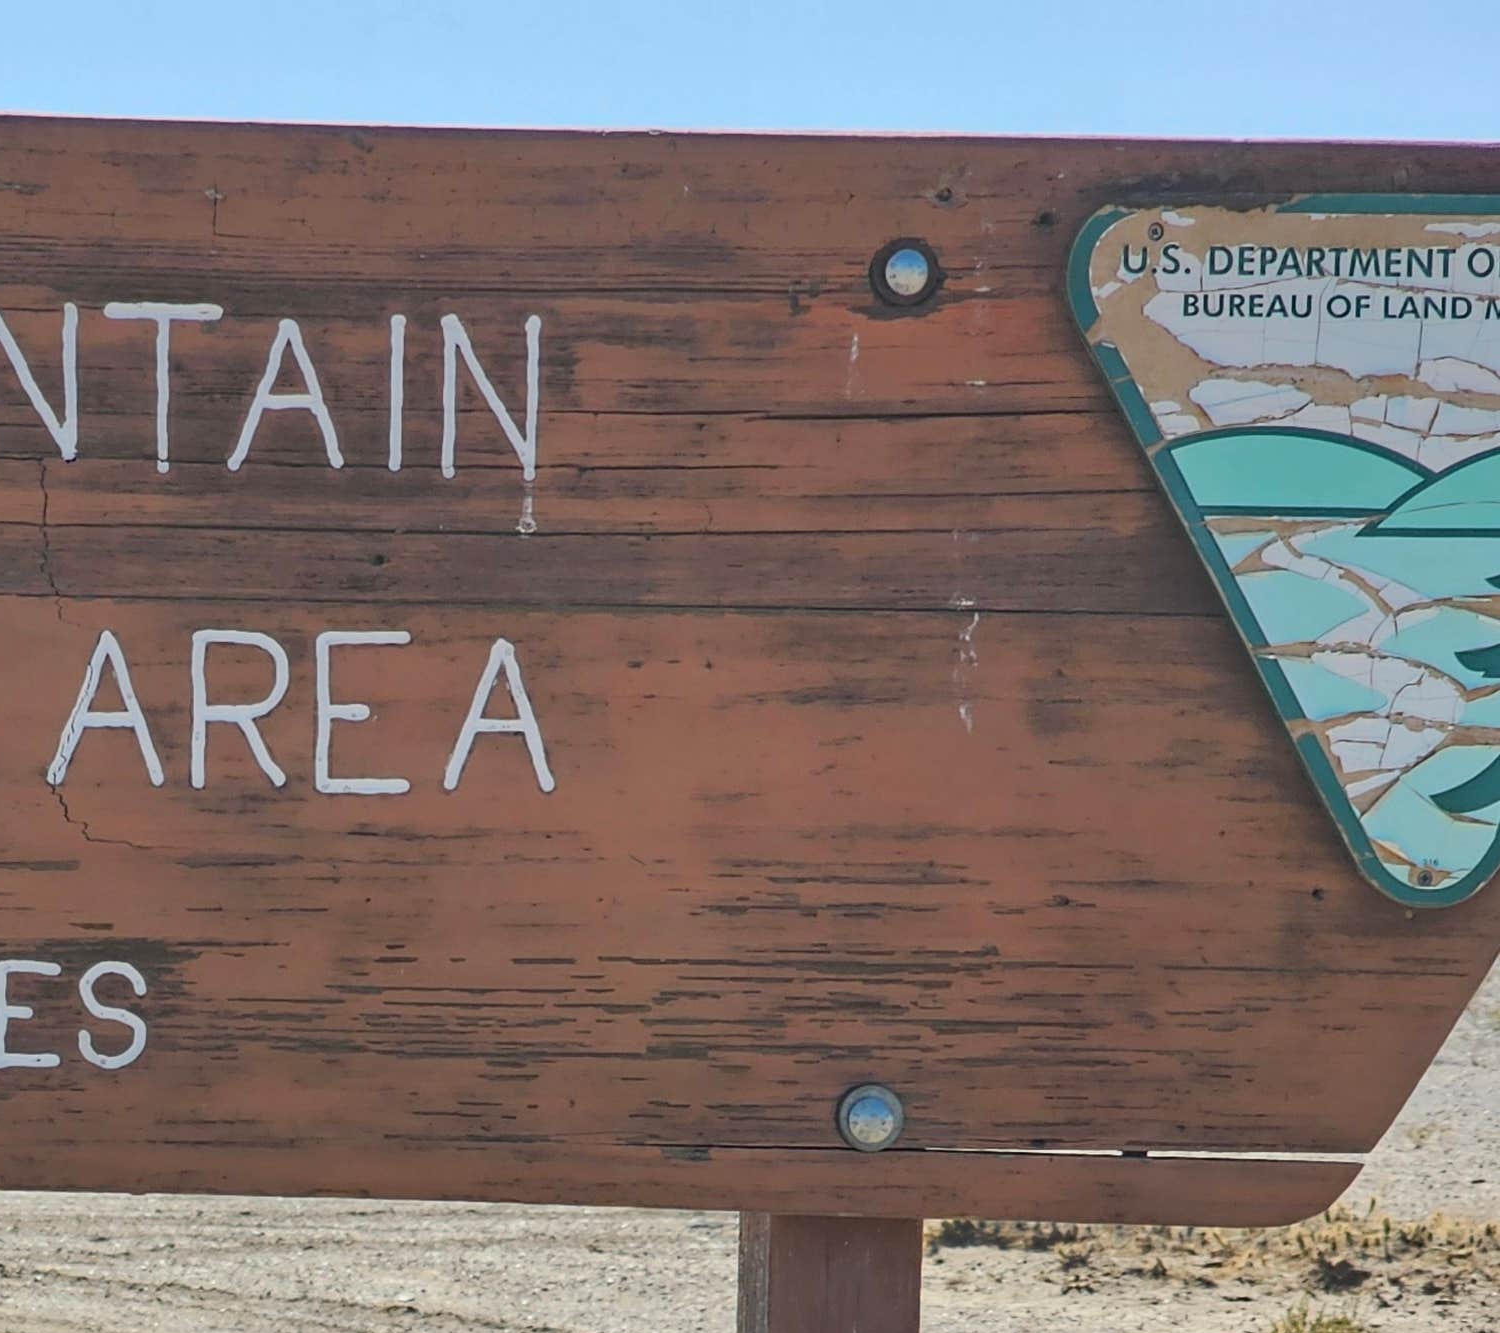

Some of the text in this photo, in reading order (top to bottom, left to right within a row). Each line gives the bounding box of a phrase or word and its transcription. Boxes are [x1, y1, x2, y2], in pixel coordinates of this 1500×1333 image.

[1122, 244, 1500, 278] U.S. DEPARTMENT O
[1182, 293, 1313, 319] BUREAU
[1326, 293, 1371, 319] OF
[1383, 294, 1473, 320] LAND
[46, 628, 556, 795] AREA
